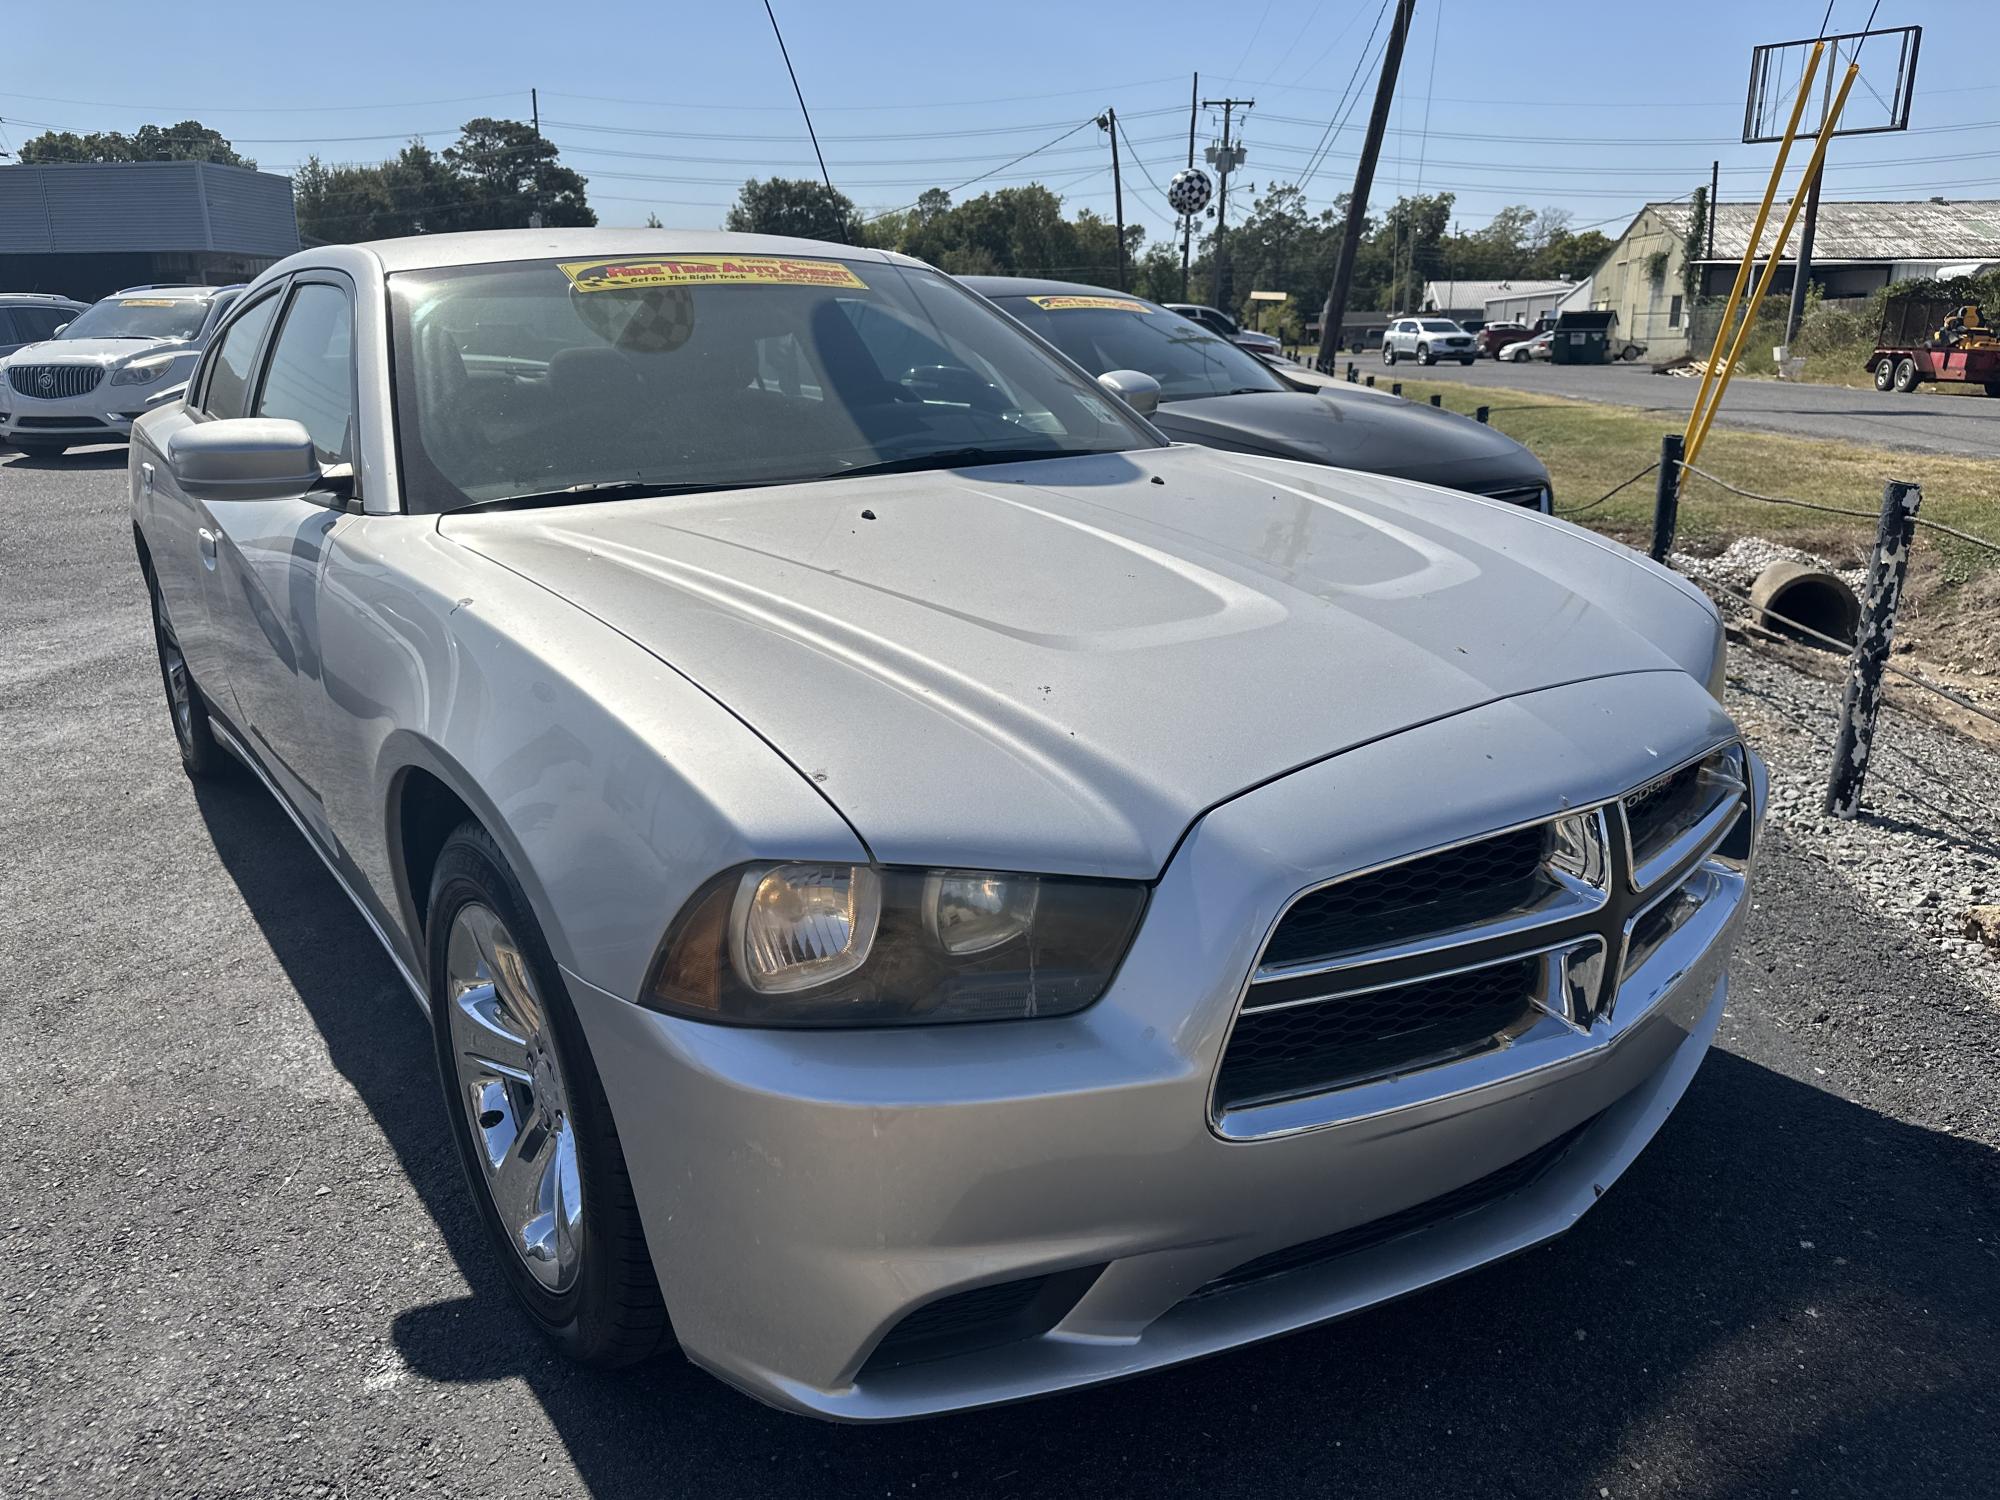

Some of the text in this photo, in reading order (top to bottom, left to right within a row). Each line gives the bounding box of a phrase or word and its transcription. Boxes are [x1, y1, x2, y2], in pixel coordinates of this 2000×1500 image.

[607, 262, 849, 279] RIDE TIME AUTO CREDIT
[689, 273, 716, 281] Right
